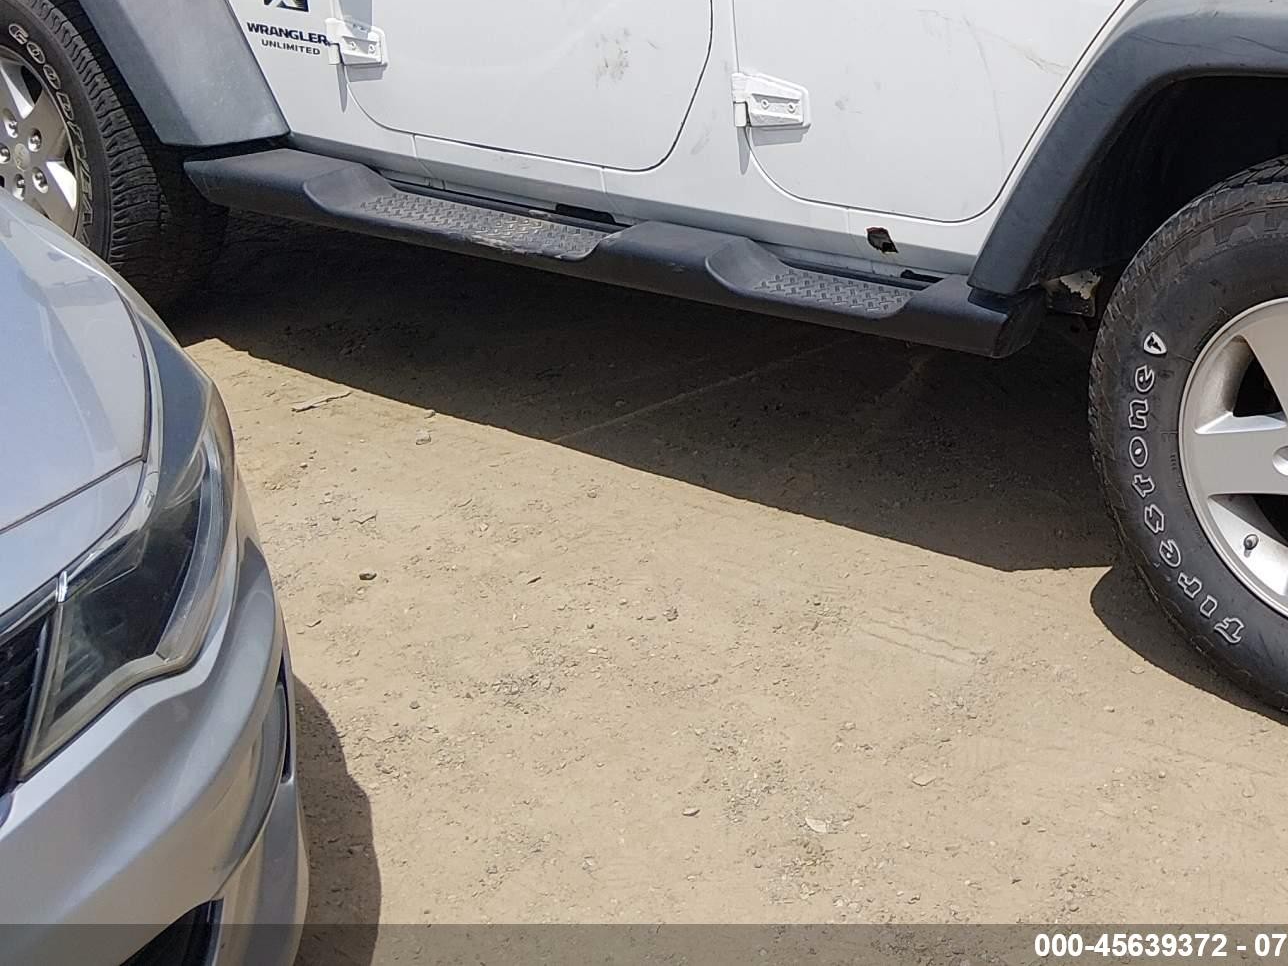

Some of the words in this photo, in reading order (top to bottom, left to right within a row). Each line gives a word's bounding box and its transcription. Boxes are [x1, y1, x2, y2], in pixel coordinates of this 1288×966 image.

[246, 21, 328, 46] WRANGLER
[261, 39, 321, 55] UNLIMITED
[1128, 364, 1245, 644] Firestone
